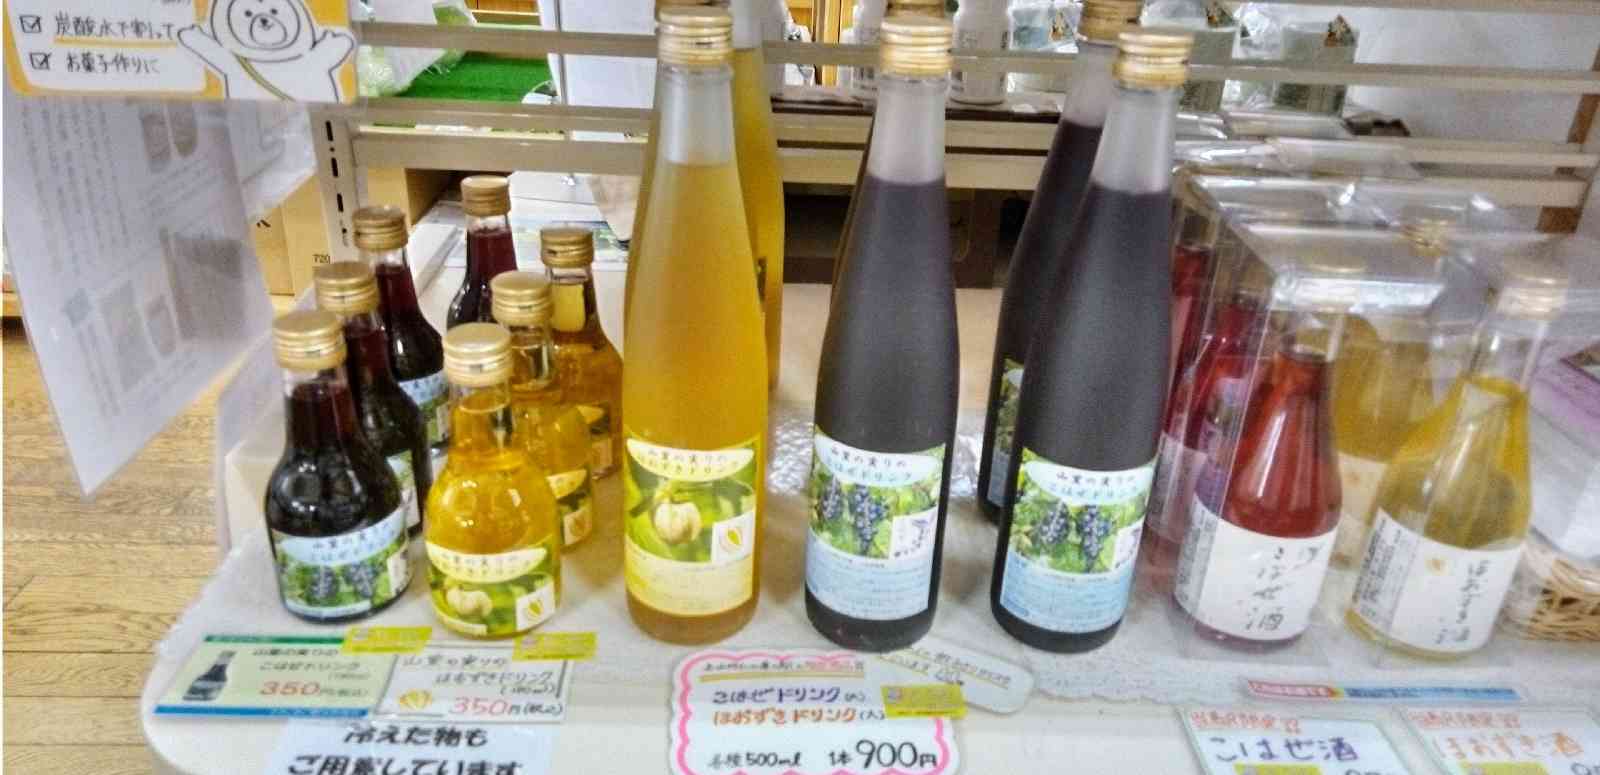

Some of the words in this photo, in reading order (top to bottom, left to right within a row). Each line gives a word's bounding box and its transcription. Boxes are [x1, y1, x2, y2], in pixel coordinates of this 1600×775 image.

[66, 52, 159, 73] お菓子作りに
[342, 724, 489, 748] 冷えた物も
